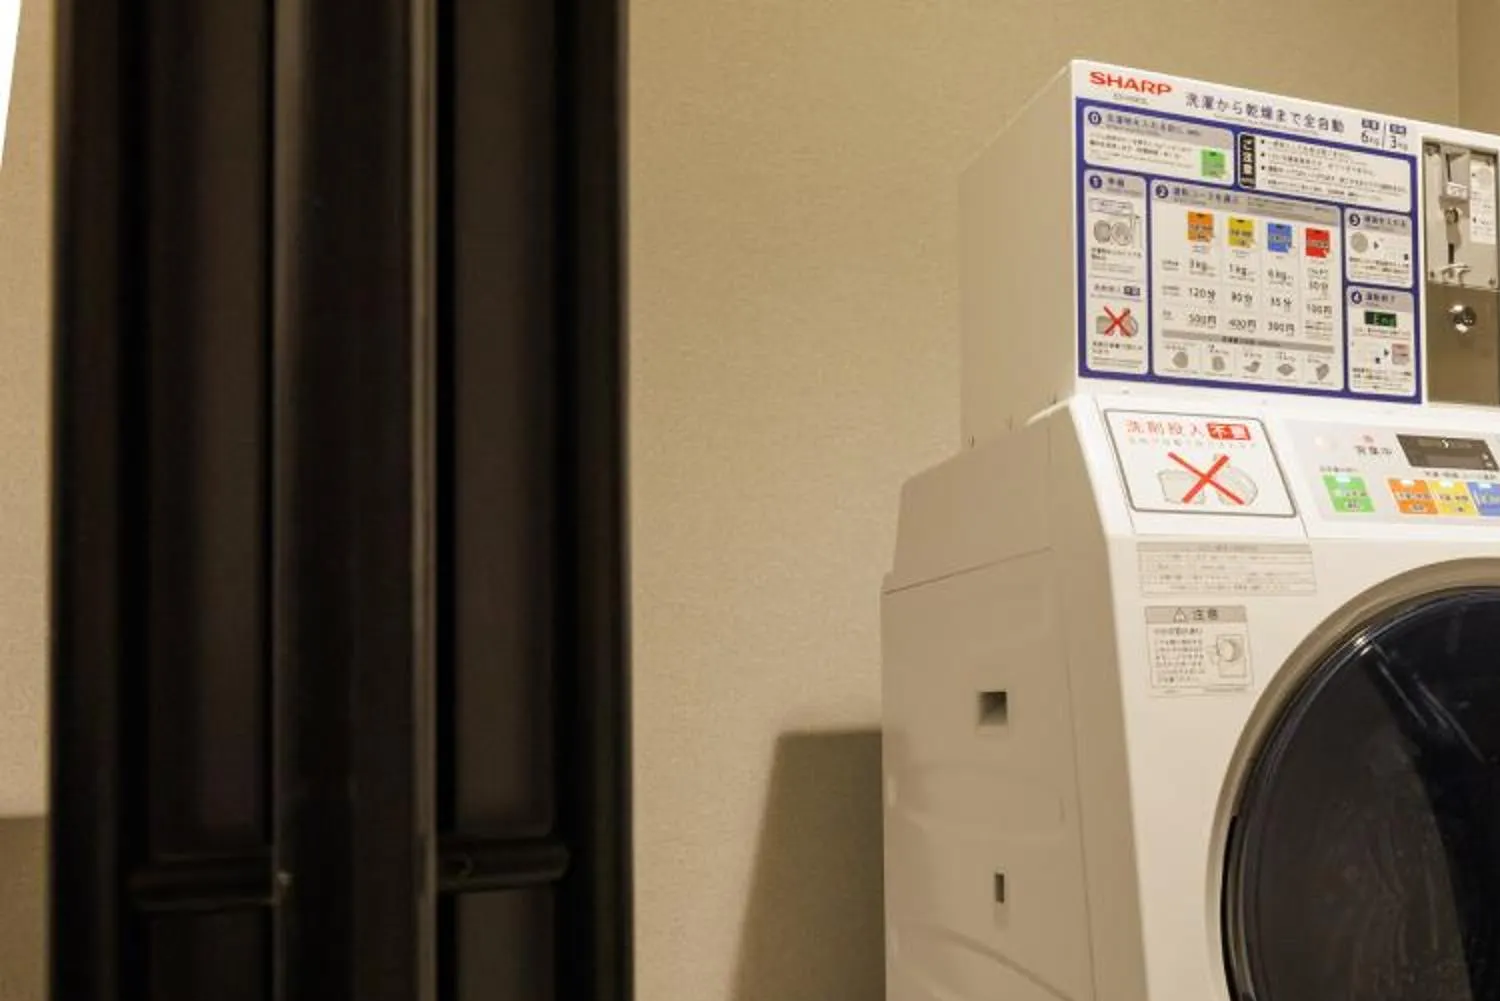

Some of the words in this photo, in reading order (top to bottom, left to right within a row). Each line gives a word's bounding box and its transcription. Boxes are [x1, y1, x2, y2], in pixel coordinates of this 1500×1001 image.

[1089, 71, 1172, 95] SHARP
[1125, 419, 1204, 437] 洗剤投入
[1192, 607, 1219, 621] 注意
